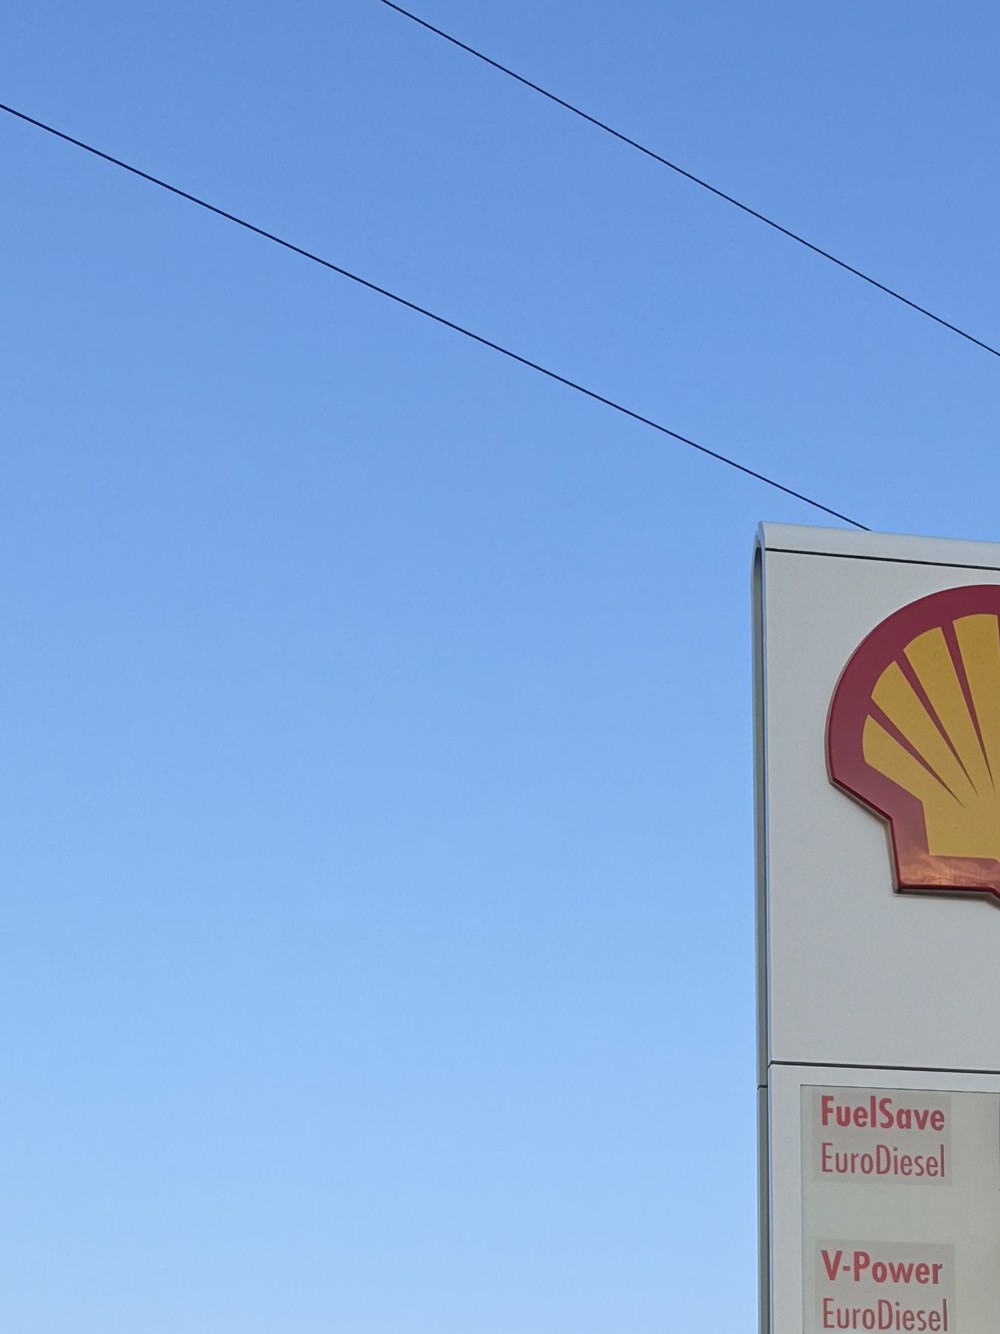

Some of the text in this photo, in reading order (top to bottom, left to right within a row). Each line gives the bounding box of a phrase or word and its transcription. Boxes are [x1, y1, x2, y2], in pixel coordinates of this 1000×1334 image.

[820, 1095, 946, 1131] FuelSave
[820, 1143, 946, 1178] EuroDiesel
[820, 1250, 944, 1285] V-Power
[821, 1298, 949, 1332] EuroDiesel
